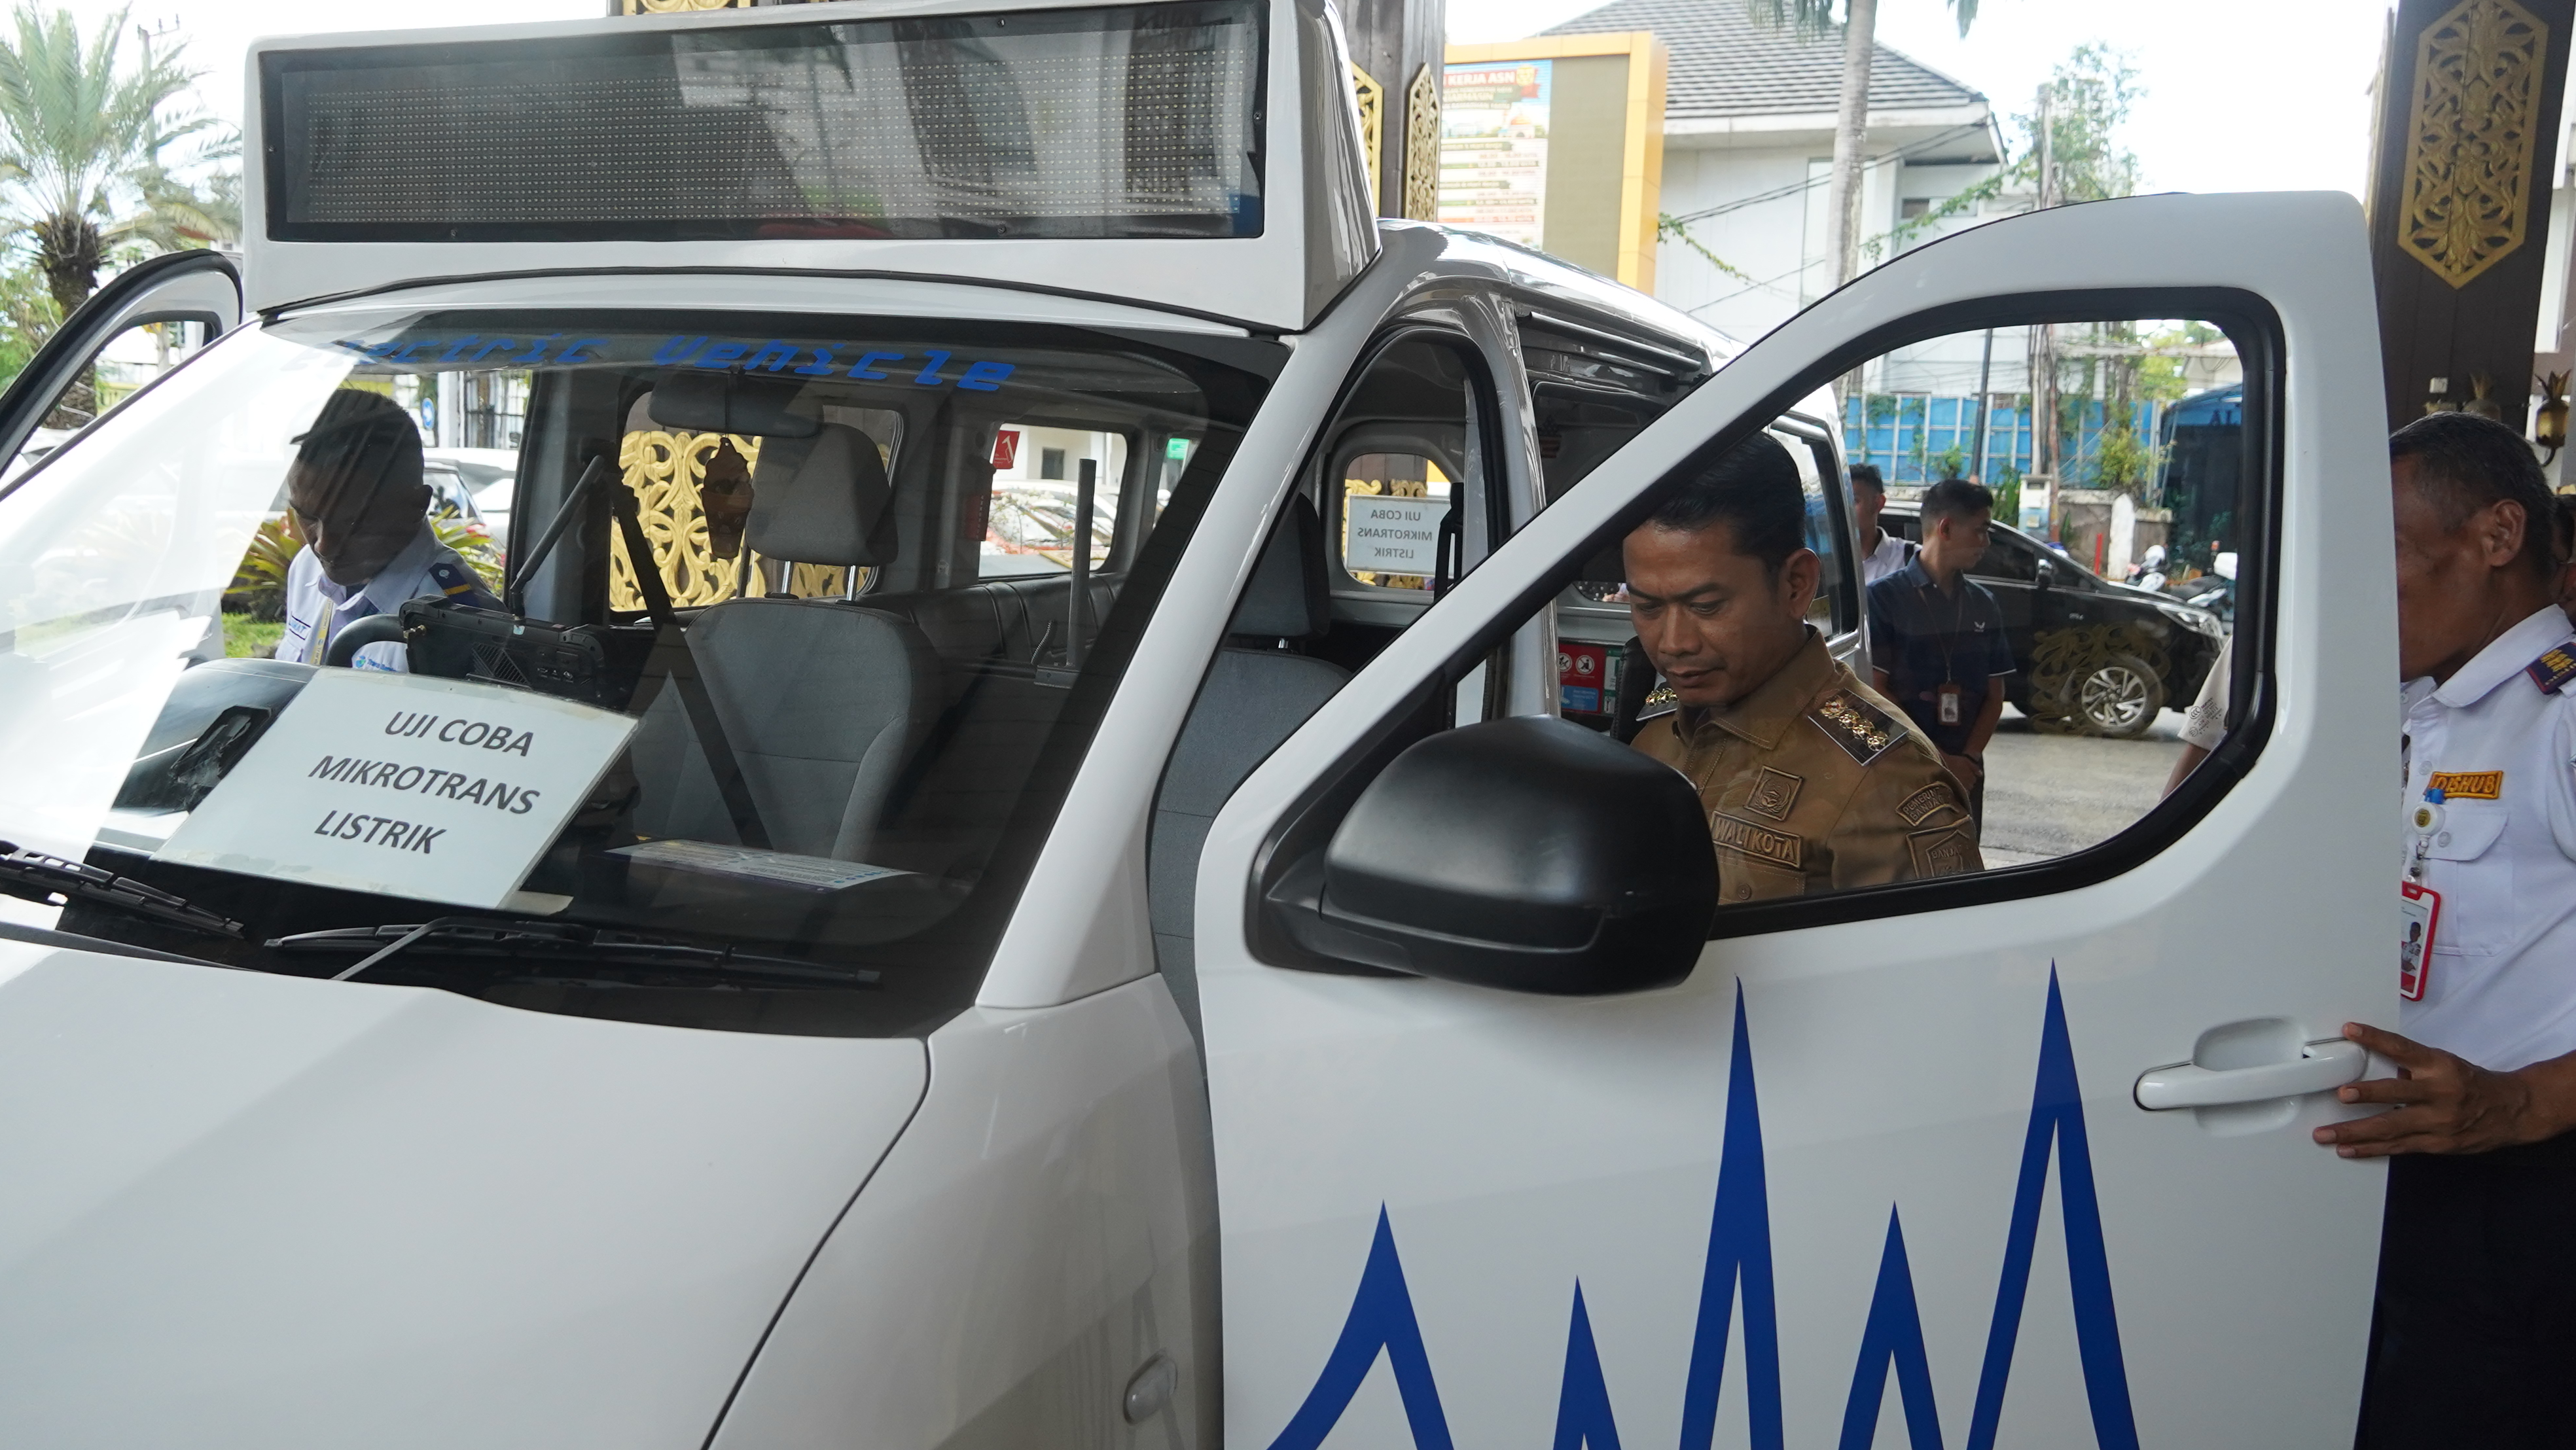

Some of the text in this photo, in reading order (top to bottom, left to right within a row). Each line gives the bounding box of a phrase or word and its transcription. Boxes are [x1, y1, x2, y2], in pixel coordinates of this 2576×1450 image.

[1448, 73, 1486, 86] KERJA
[1484, 71, 1512, 83] ASN
[654, 334, 1015, 391] Vehicle
[385, 711, 534, 756] UJI COBA
[308, 755, 540, 815] MIKROTRANS
[314, 809, 446, 854] LISTRIK
